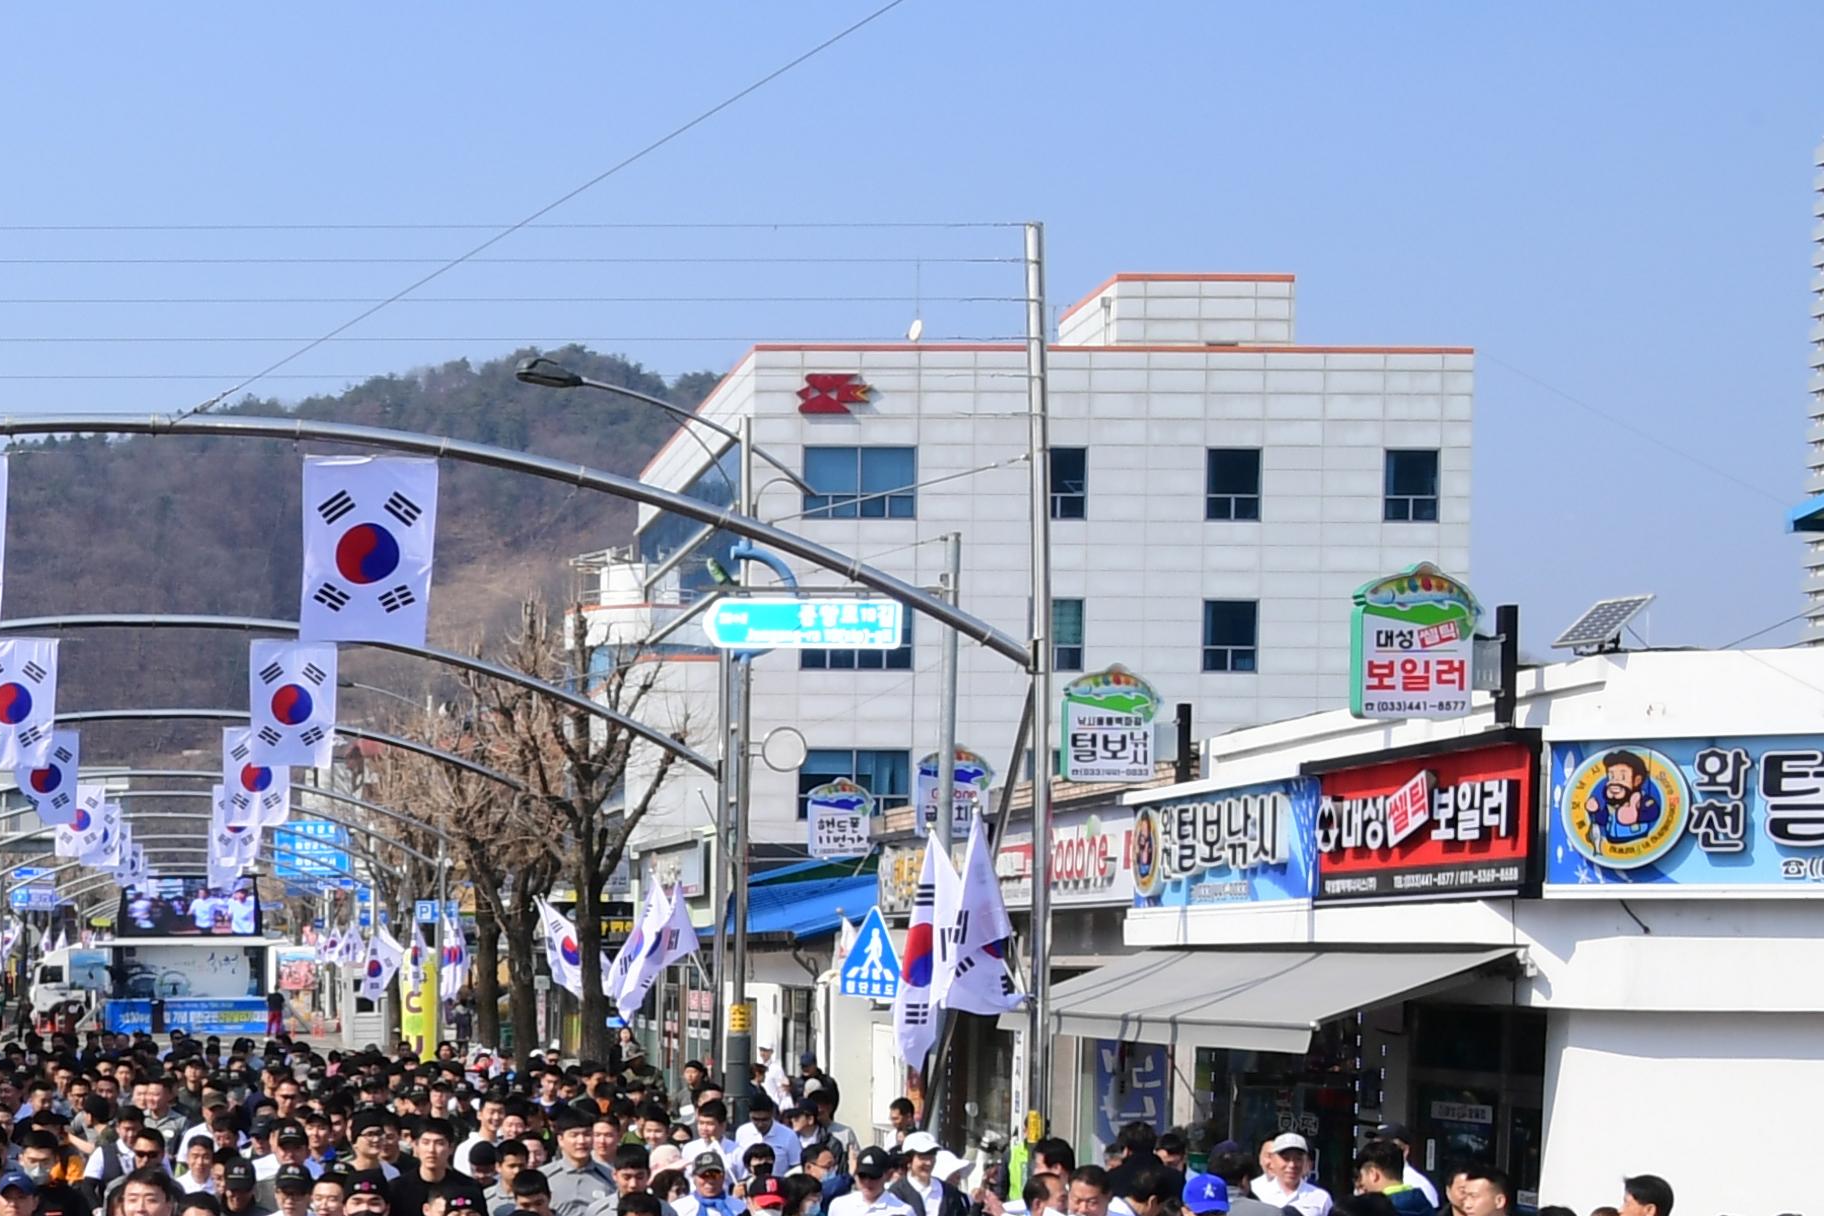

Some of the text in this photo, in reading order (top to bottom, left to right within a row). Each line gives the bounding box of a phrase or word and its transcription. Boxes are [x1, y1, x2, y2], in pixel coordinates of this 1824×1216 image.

[1376, 629, 1414, 649] 대성
[1366, 659, 1465, 691] 보일러
[1377, 701, 1466, 712] (033)441-8577
[1071, 731, 1148, 765] 털보 낚시
[818, 816, 860, 832] 핸드폰
[1341, 795, 1386, 850] 대성
[1430, 779, 1509, 841] 보일러
[1176, 794, 1279, 869] 털보낚시
